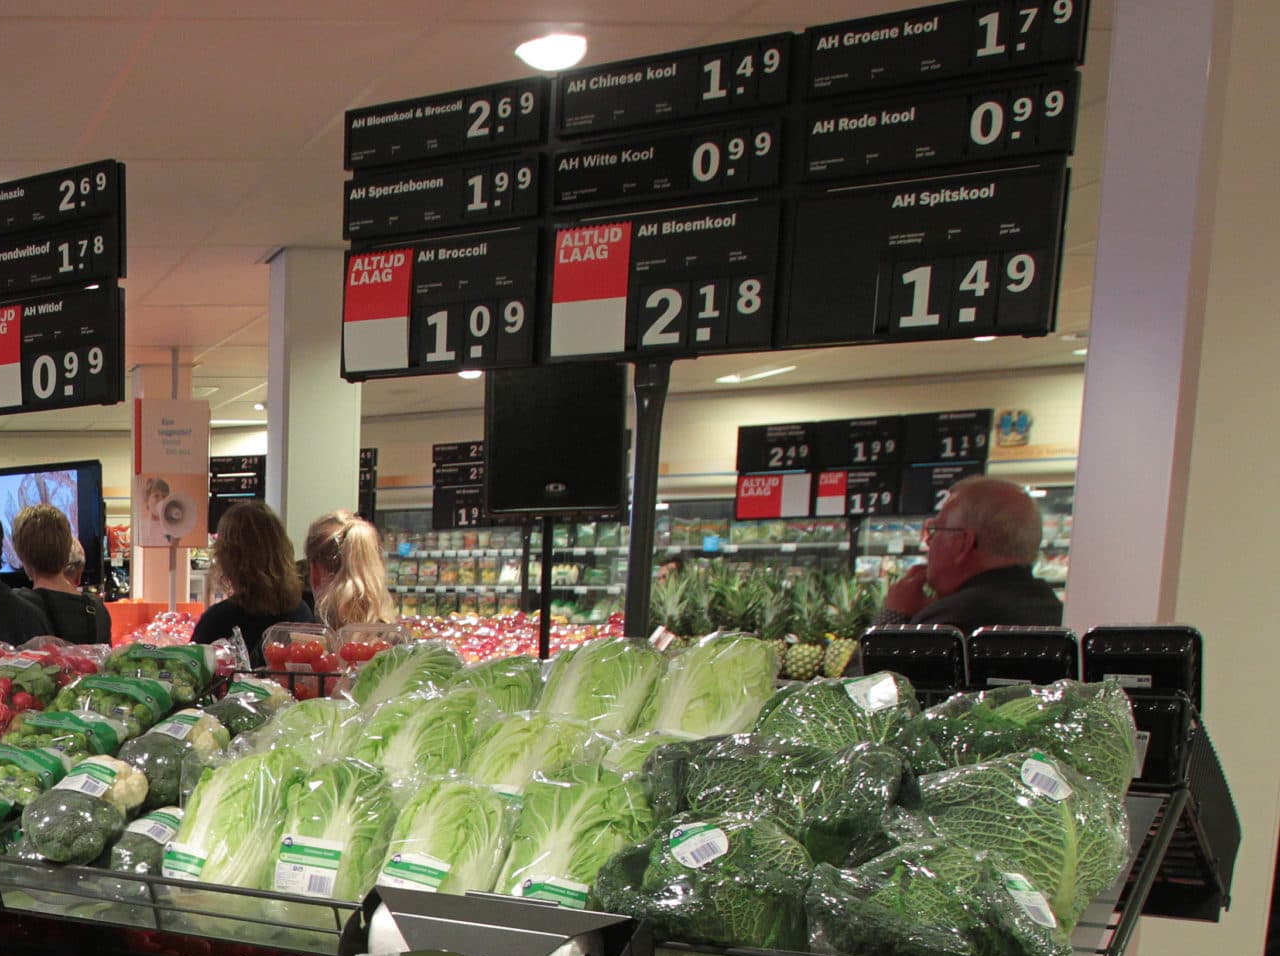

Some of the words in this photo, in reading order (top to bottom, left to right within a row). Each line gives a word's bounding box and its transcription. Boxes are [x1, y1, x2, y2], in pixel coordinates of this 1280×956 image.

[816, 37, 839, 51] AH
[843, 27, 899, 48] Groene
[903, 17, 939, 36] kool
[976, 0, 1073, 57] 1.79
[567, 79, 586, 94] AH
[589, 72, 642, 89] Chinese
[646, 64, 677, 80] kool
[702, 48, 781, 100] 1.49
[352, 119, 365, 129] AH
[367, 113, 414, 127] Bloemkool
[415, 108, 423, 118] &
[424, 101, 463, 117] Broccoli
[467, 91, 535, 138] 2.69
[812, 121, 834, 134] AH
[837, 114, 877, 132] Rode
[880, 107, 916, 125] kool
[970, 90, 1065, 146] 0.99
[558, 157, 579, 172] AH
[582, 151, 617, 169] Witte
[621, 147, 654, 164] Kool
[691, 131, 772, 183] 0.99
[59, 172, 107, 211] 2.69
[350, 187, 366, 200] AH
[368, 176, 444, 199] Sperziebonen
[467, 167, 532, 211] 1.99
[891, 194, 916, 208] AH
[919, 183, 995, 207] Spitskool
[560, 227, 623, 248] ALTIJD
[637, 223, 658, 237] AH
[662, 213, 736, 234] Bloemkool
[58, 235, 104, 273] 1.78
[352, 253, 405, 271] ALTIJD
[418, 250, 435, 263] AH
[438, 243, 488, 260] Broccoli
[558, 245, 609, 264] LAAG
[350, 269, 393, 287] LAAG
[899, 253, 1035, 329] 1.49
[23, 306, 37, 317] AH
[37, 301, 63, 316] Witlof
[641, 278, 762, 346] 2.18
[425, 300, 525, 362] 1.09
[32, 347, 103, 399] 0.99
[769, 445, 809, 467] 2.49
[740, 486, 772, 497] LAAG
[850, 492, 892, 514] 1.79
